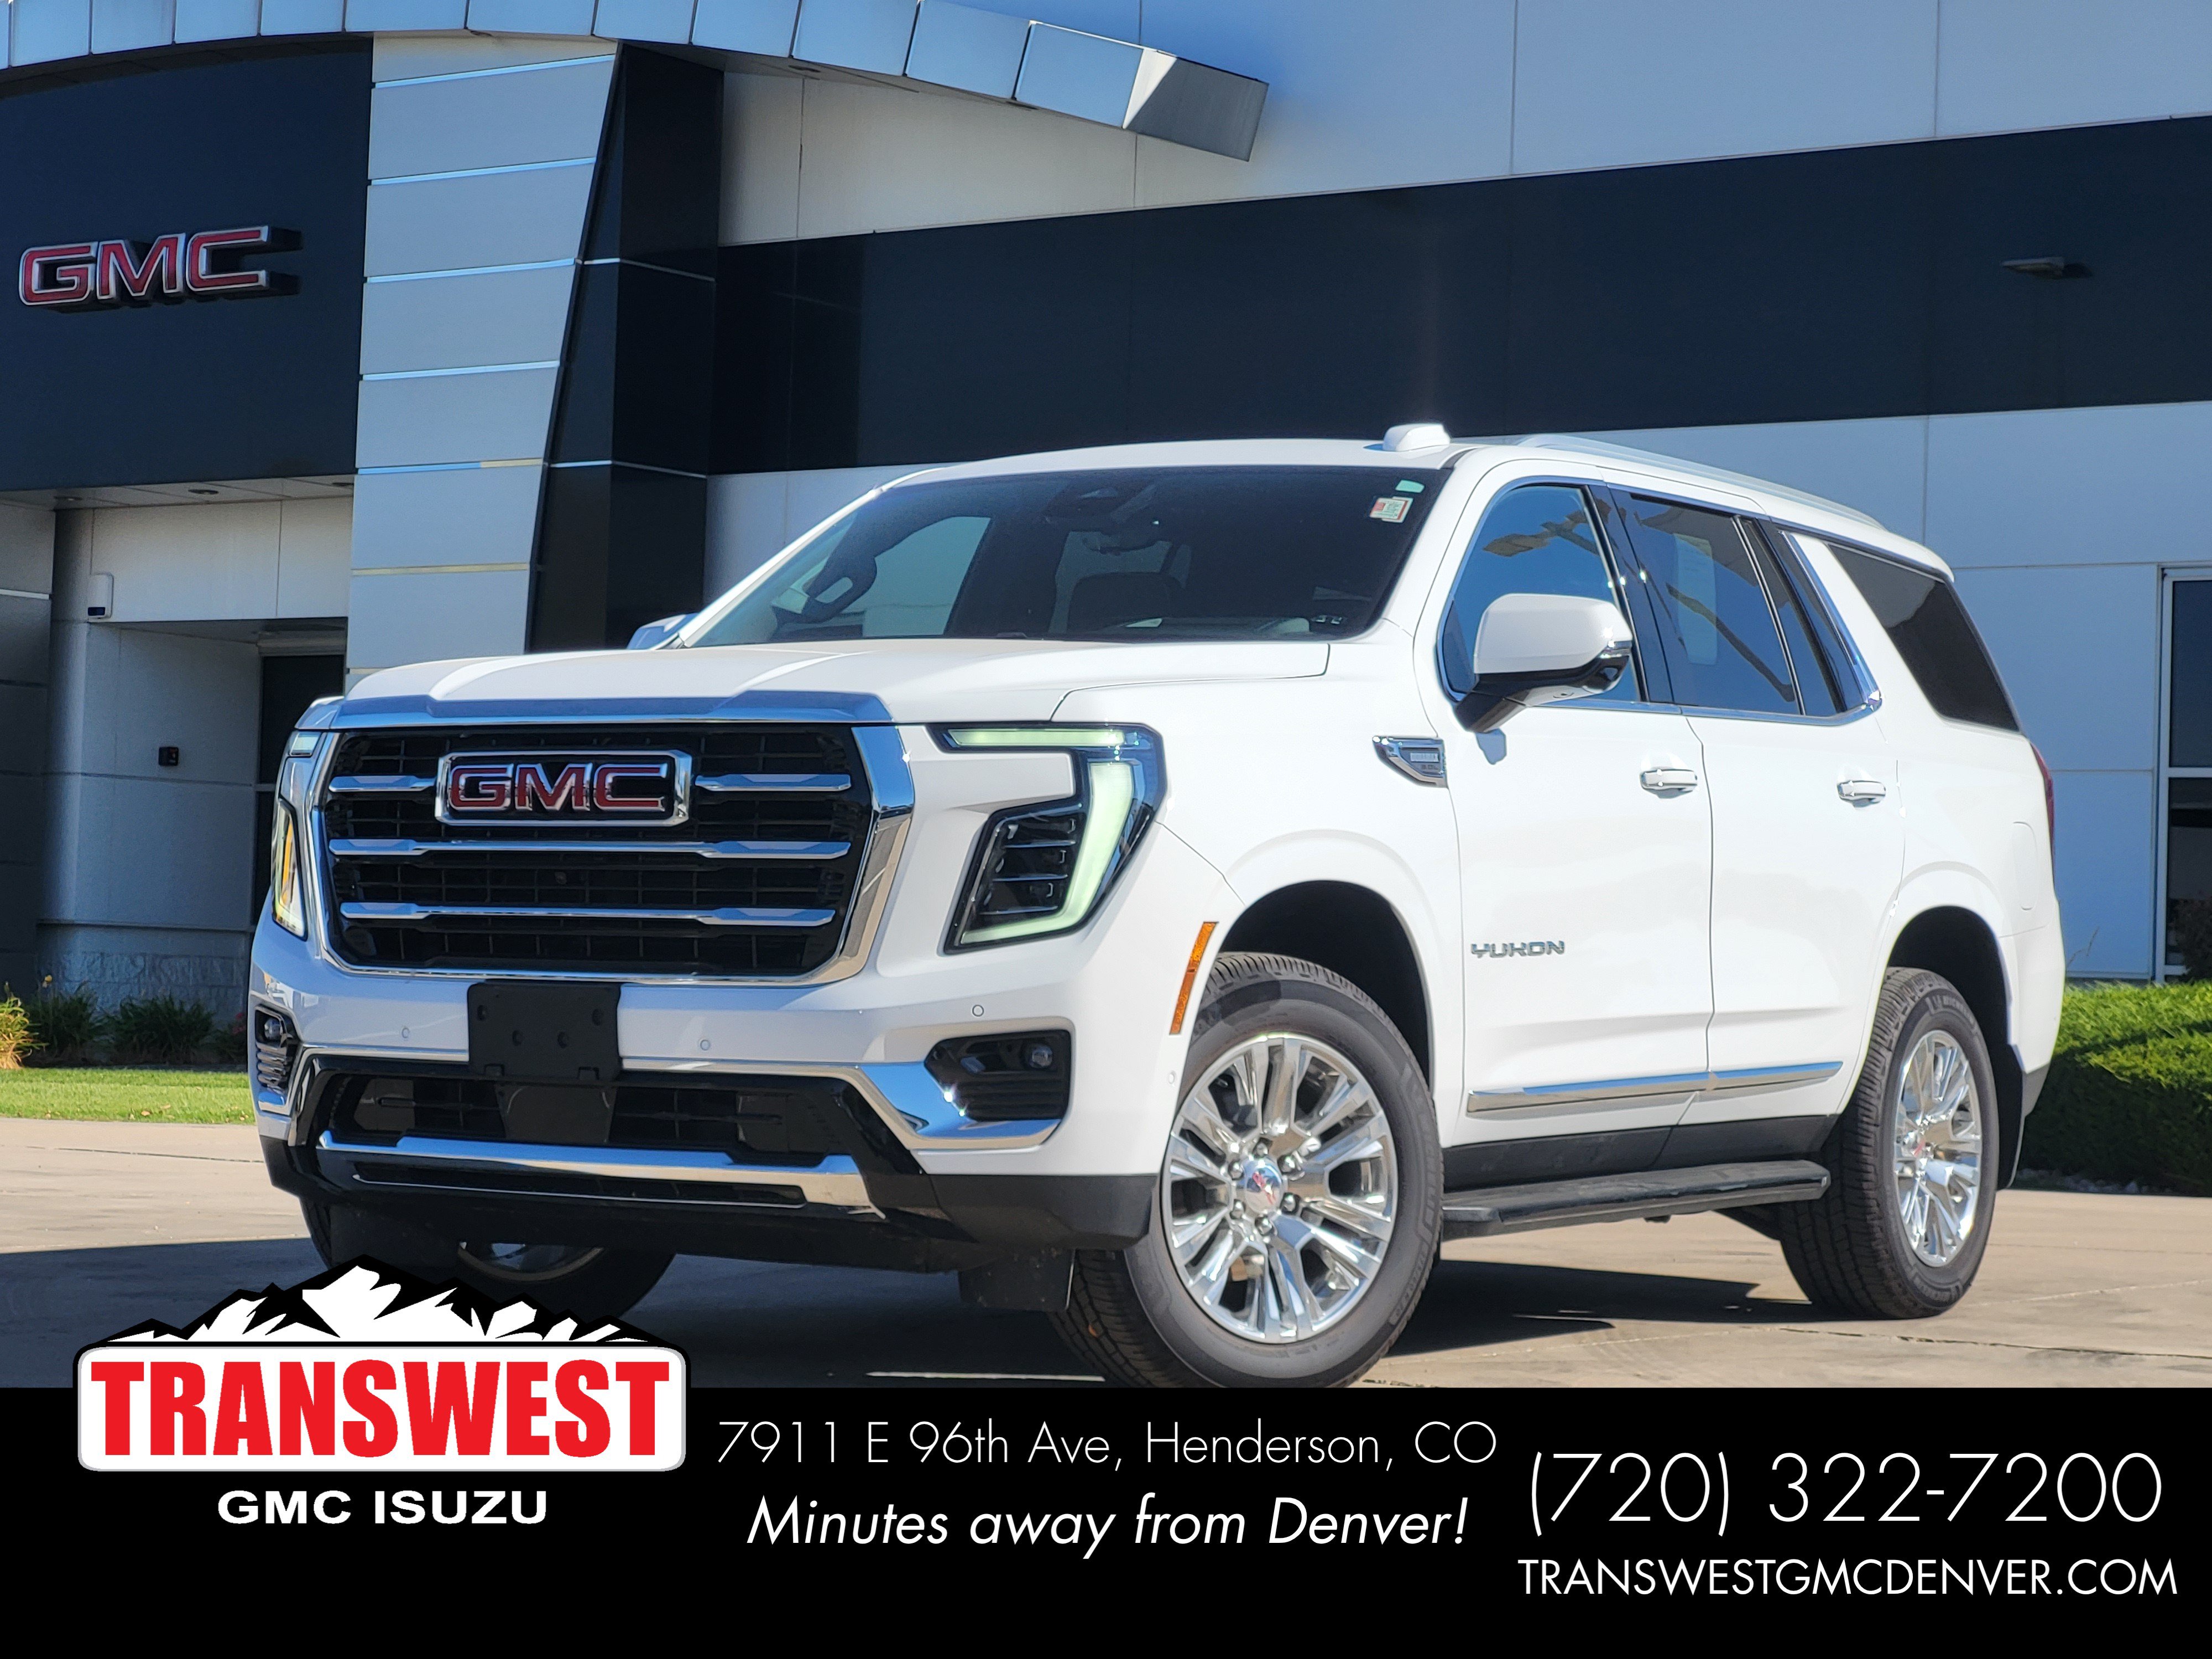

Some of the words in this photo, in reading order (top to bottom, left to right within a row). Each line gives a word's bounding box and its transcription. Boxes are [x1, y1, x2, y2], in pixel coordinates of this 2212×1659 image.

[19, 225, 269, 306] GMC
[448, 763, 668, 812] GMC
[1471, 940, 1565, 958] YUKON
